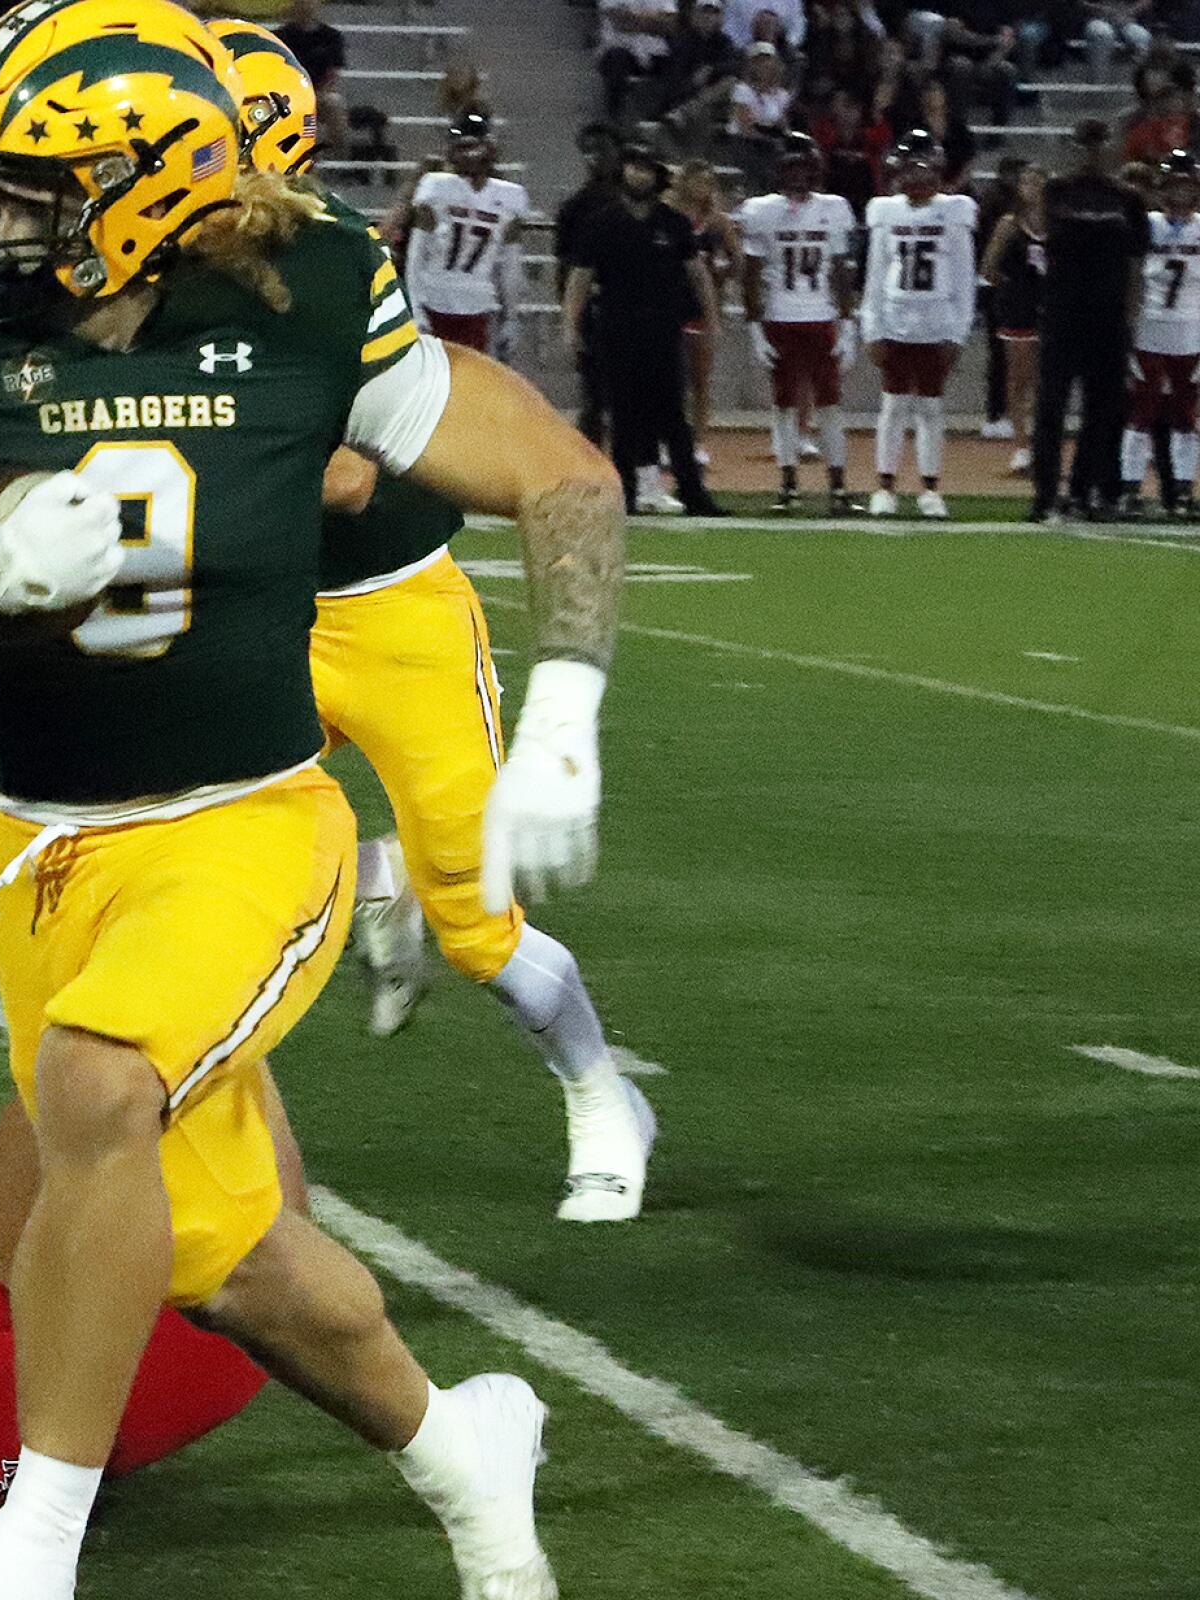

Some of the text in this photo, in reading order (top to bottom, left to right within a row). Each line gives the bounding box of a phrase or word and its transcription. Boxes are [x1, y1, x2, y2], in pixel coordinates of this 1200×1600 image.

[443, 222, 492, 274] 17
[1164, 259, 1186, 309] 7
[38, 394, 237, 435] CHARGERS
